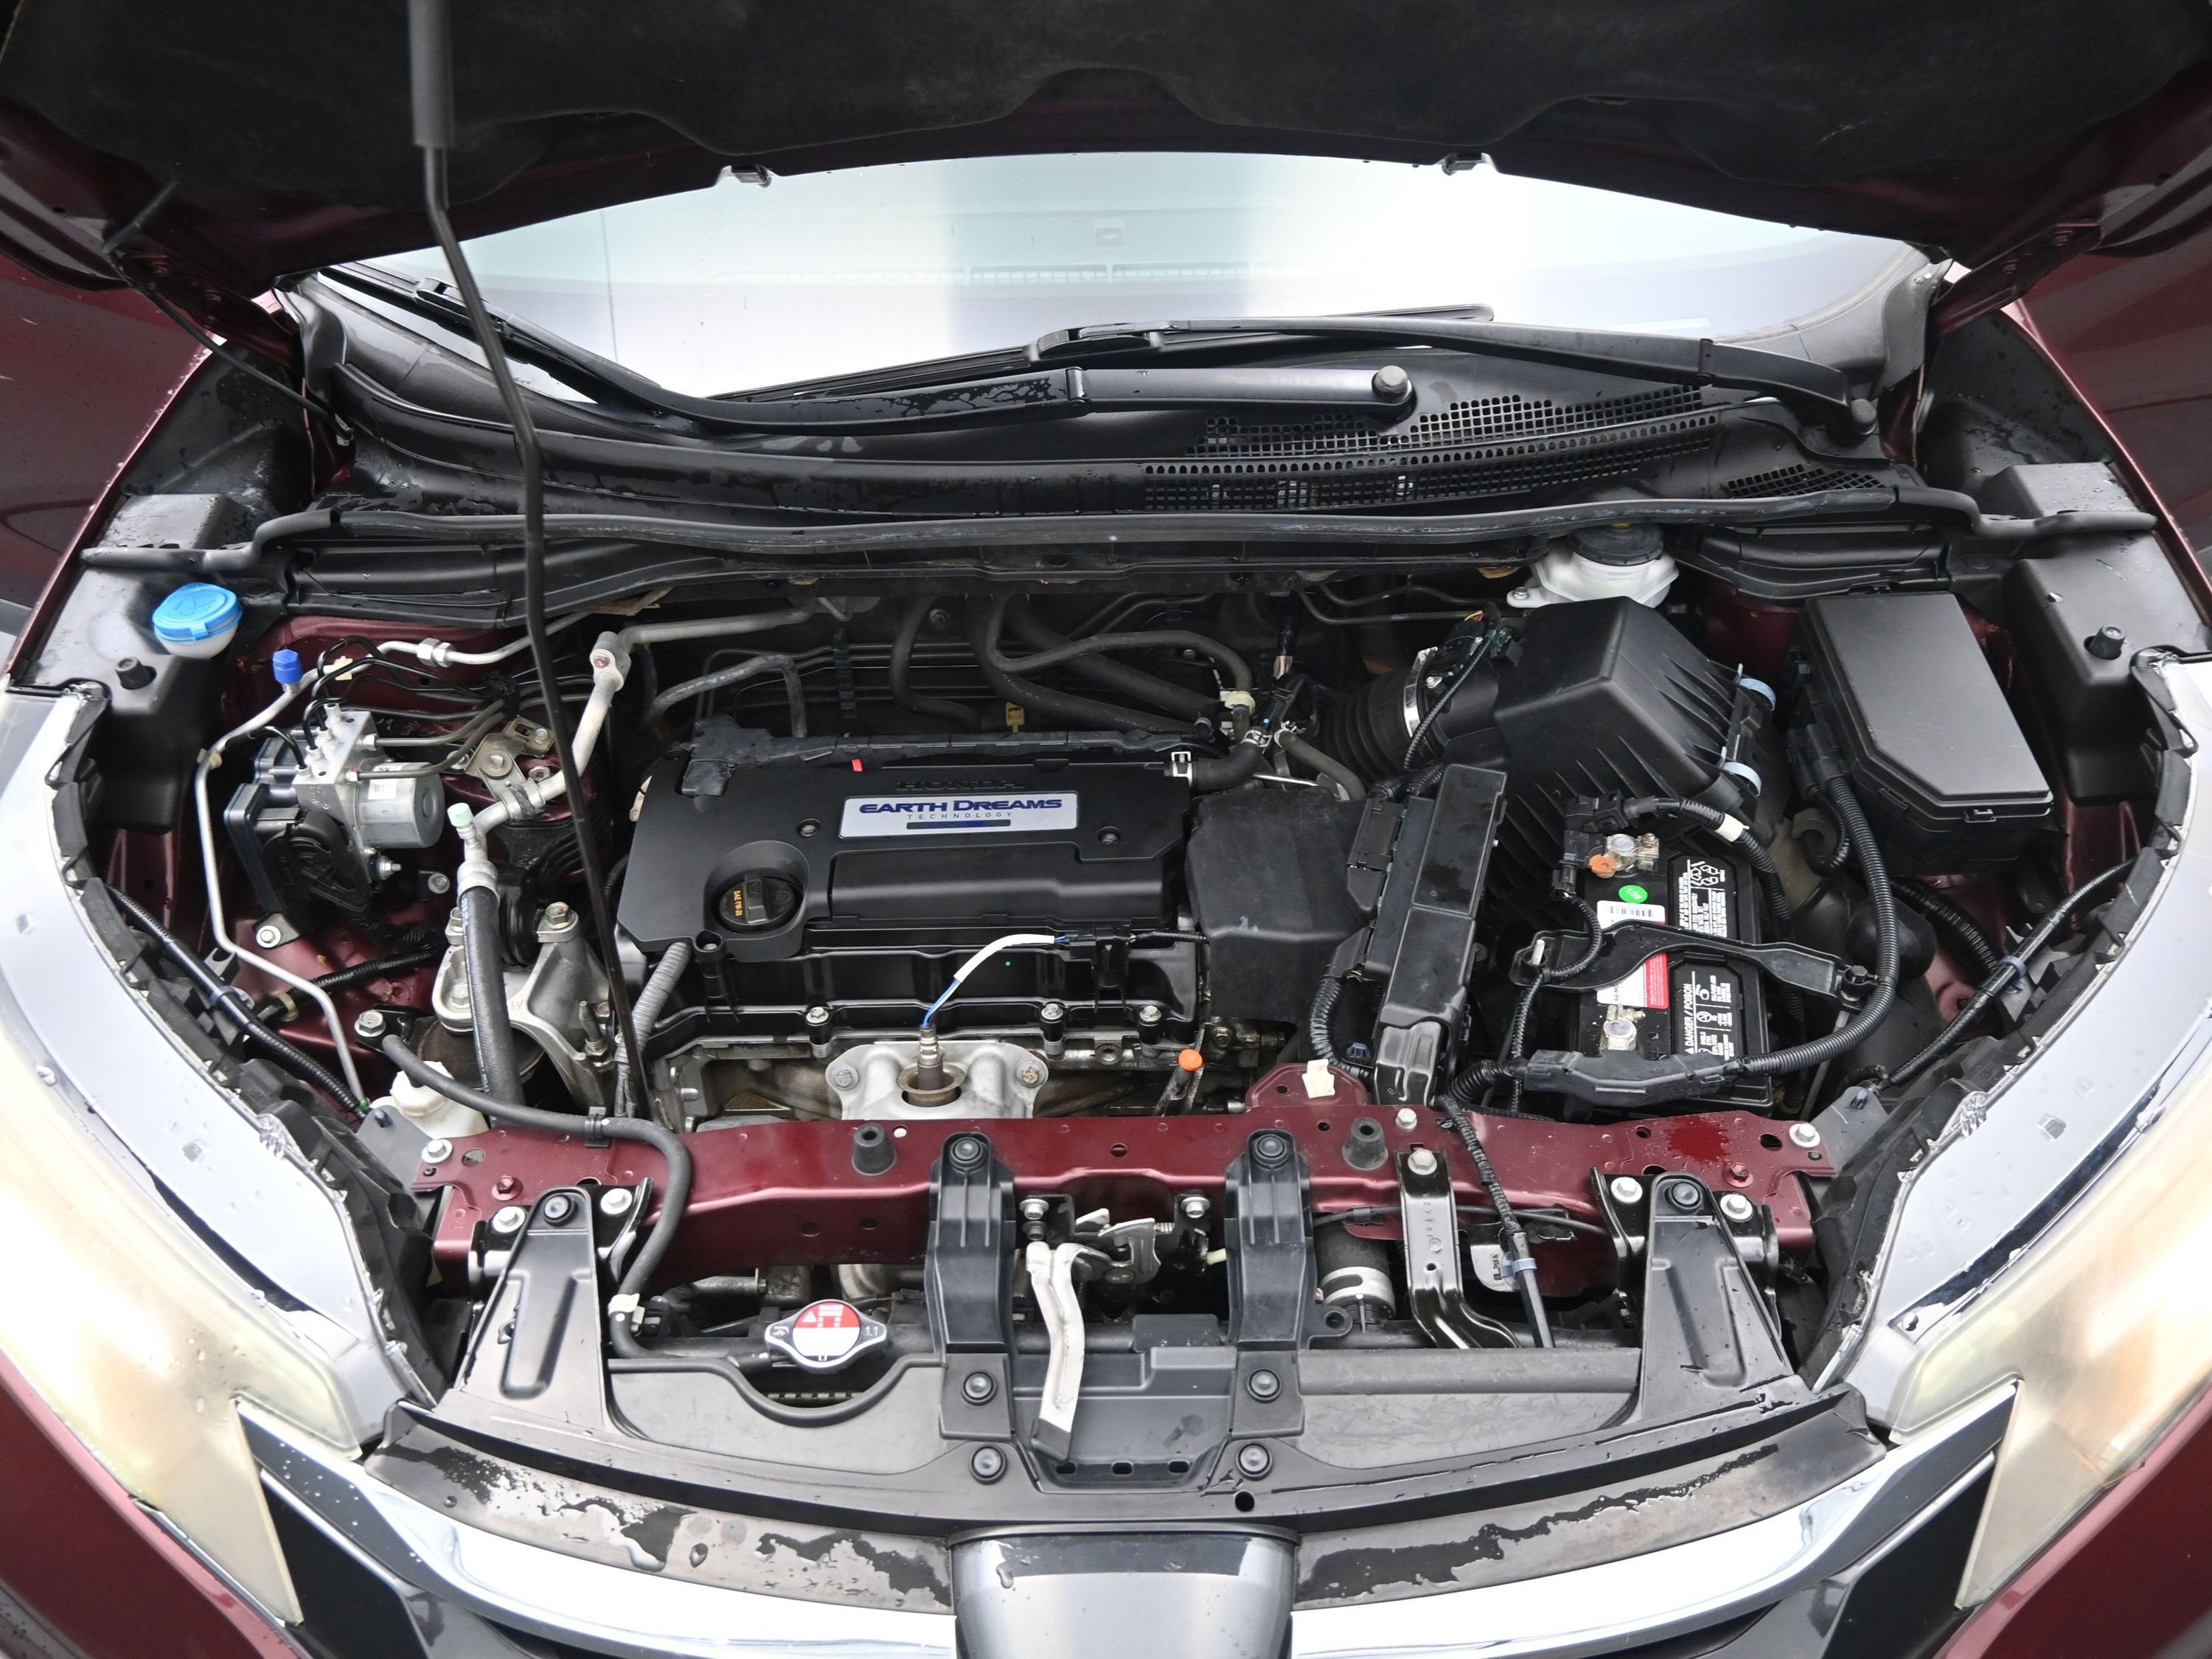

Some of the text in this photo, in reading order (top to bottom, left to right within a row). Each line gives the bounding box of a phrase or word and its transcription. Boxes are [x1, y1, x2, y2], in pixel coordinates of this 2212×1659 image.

[859, 799, 1062, 814] EARTH DREAMS
[907, 812, 1014, 820] TECHNOLOGY
[733, 890, 741, 901] SAE
[1683, 984, 1693, 1009] POISON
[1684, 1016, 1694, 1046] DANGER
[865, 1326, 878, 1337] 1.1
